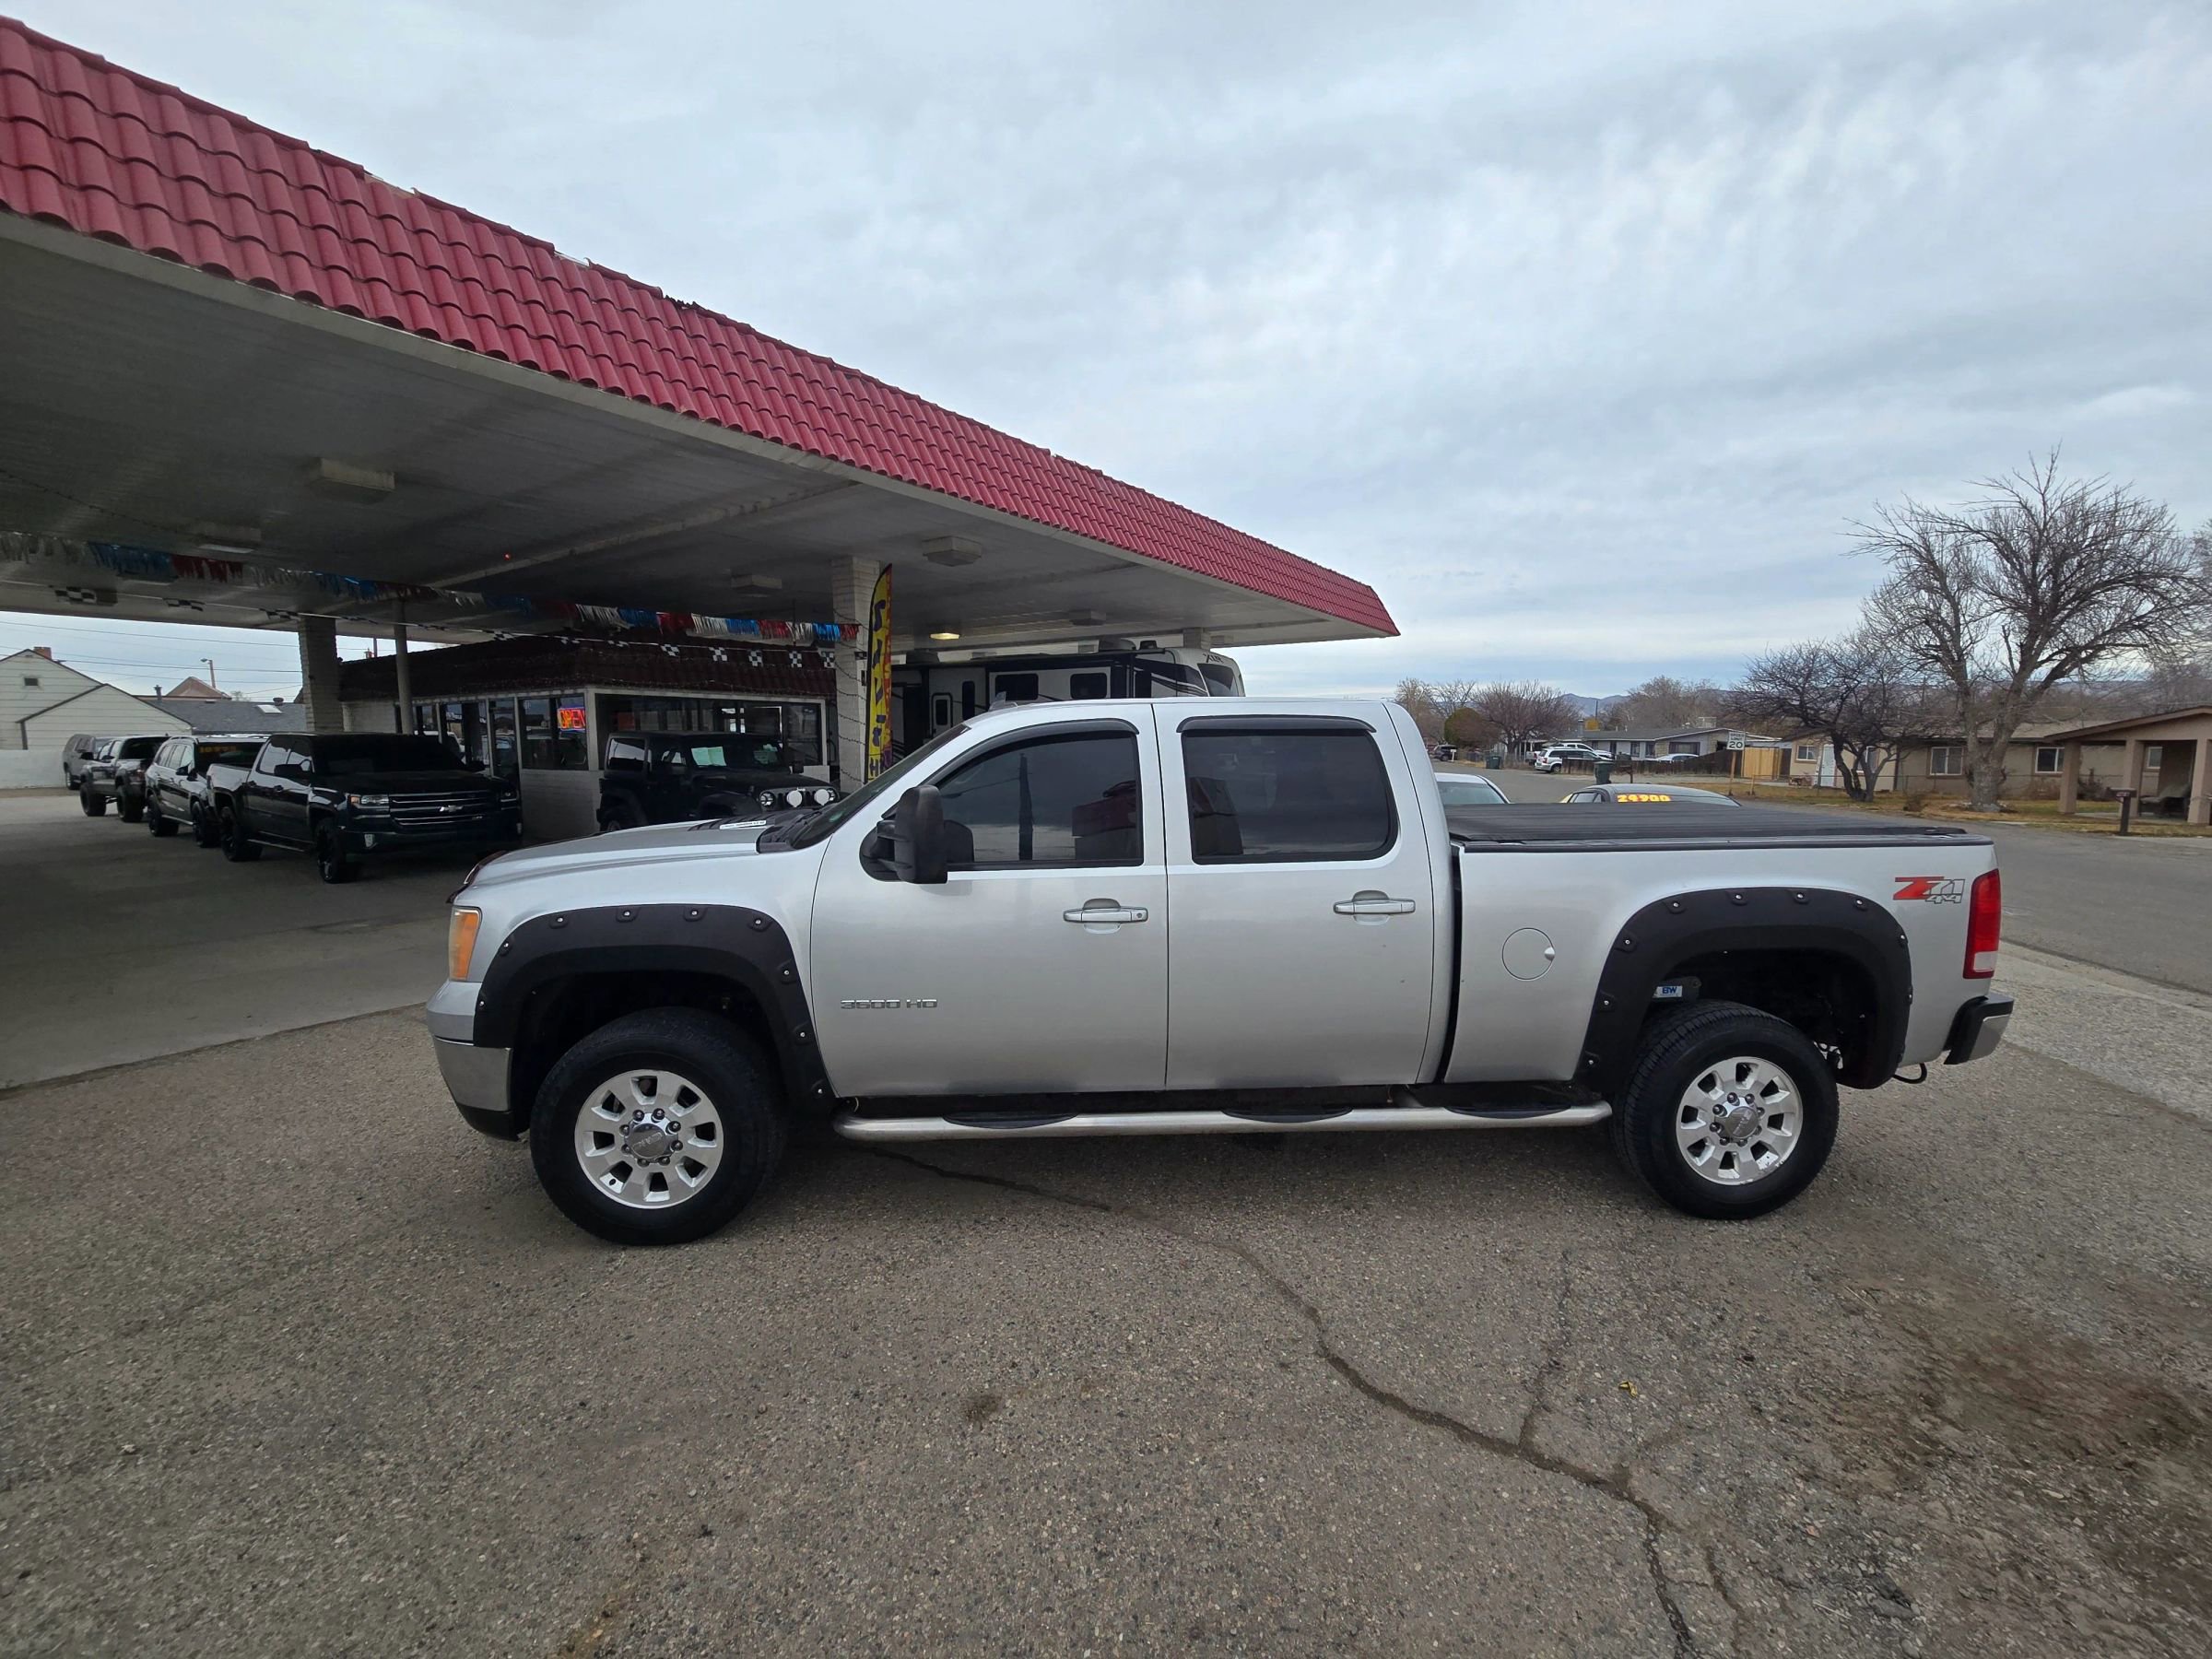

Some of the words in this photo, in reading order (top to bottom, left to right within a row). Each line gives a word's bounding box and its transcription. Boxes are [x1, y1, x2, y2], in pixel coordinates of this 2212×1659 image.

[559, 709, 585, 729] OPEN
[1892, 876, 1965, 900] Z71
[906, 999, 937, 1009] HD
